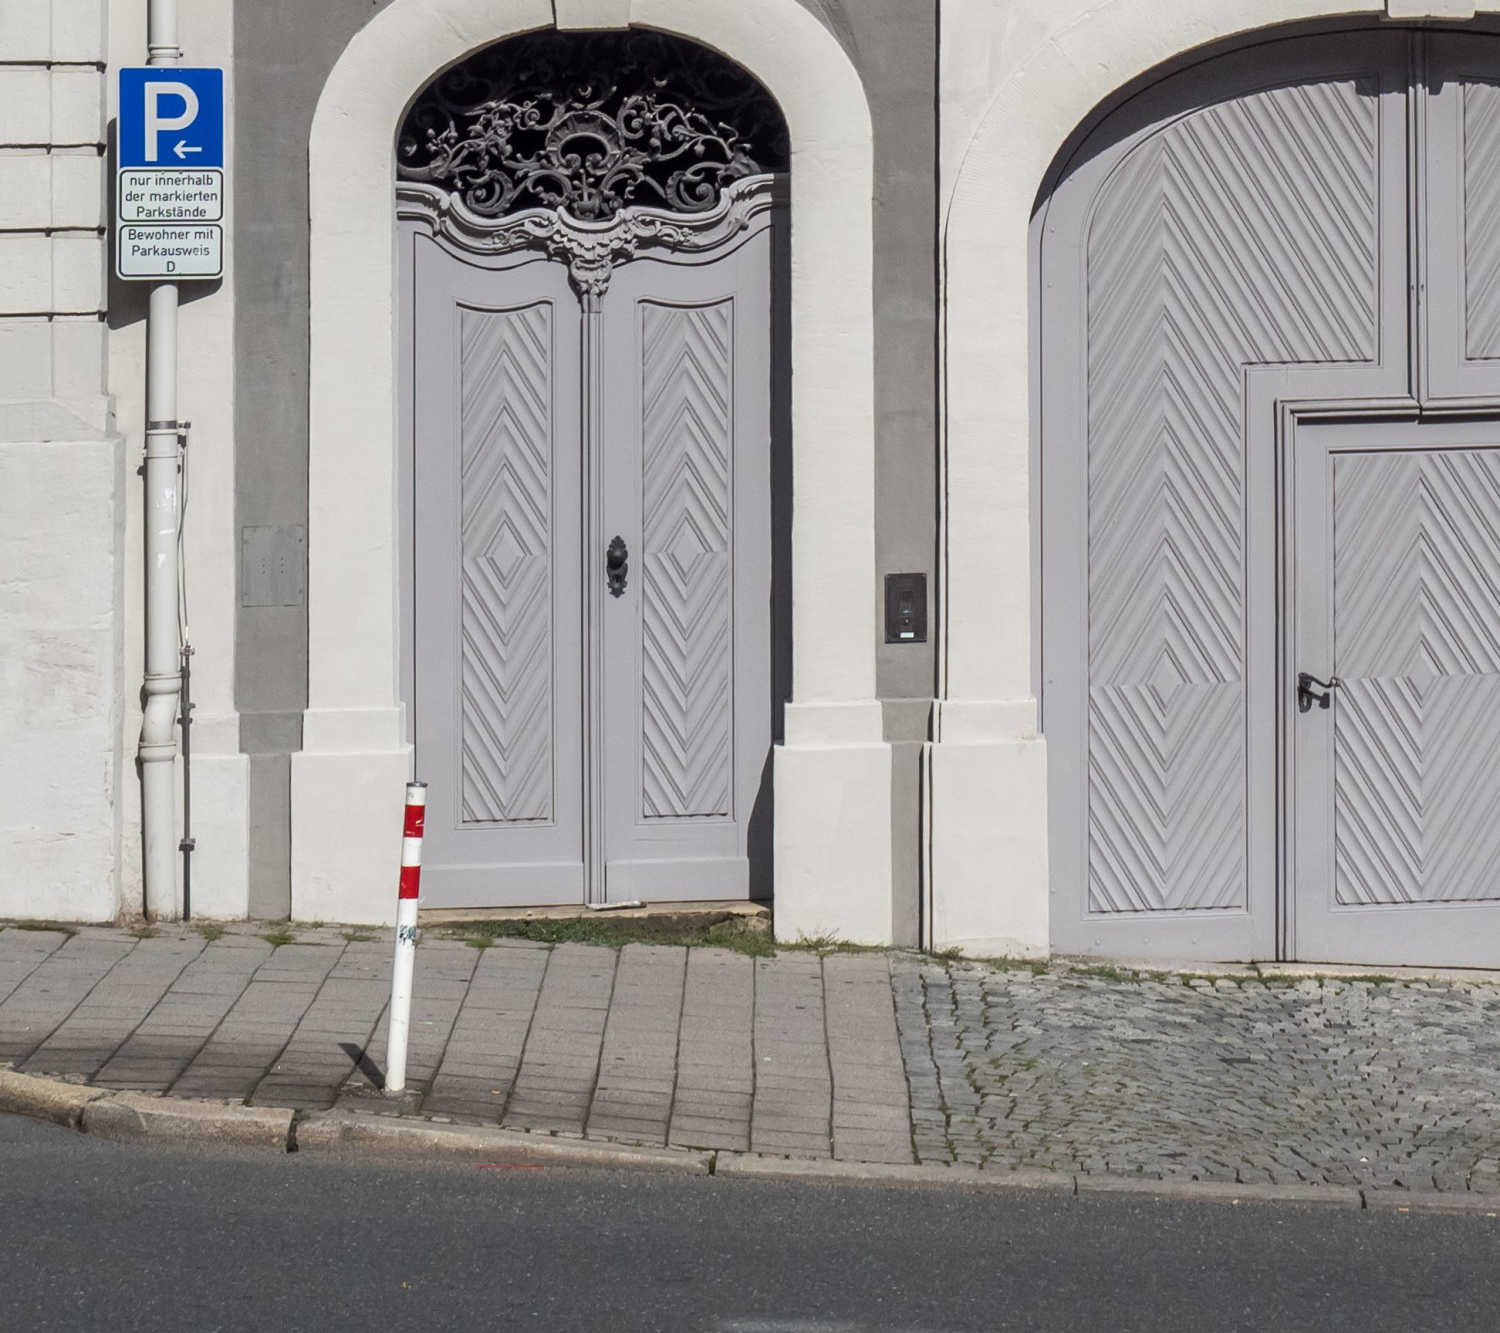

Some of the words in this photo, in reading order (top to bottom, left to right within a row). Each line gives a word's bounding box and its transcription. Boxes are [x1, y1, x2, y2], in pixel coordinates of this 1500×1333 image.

[144, 81, 199, 162] P
[130, 177, 151, 186] nur
[155, 175, 213, 186] innerhalb
[125, 191, 145, 201] der
[149, 190, 217, 201] markierten
[136, 206, 206, 217] Parkstände
[128, 229, 190, 240] Bewohner
[194, 229, 213, 239] mit
[132, 245, 209, 256] Parkausweis
[166, 261, 176, 272] D
